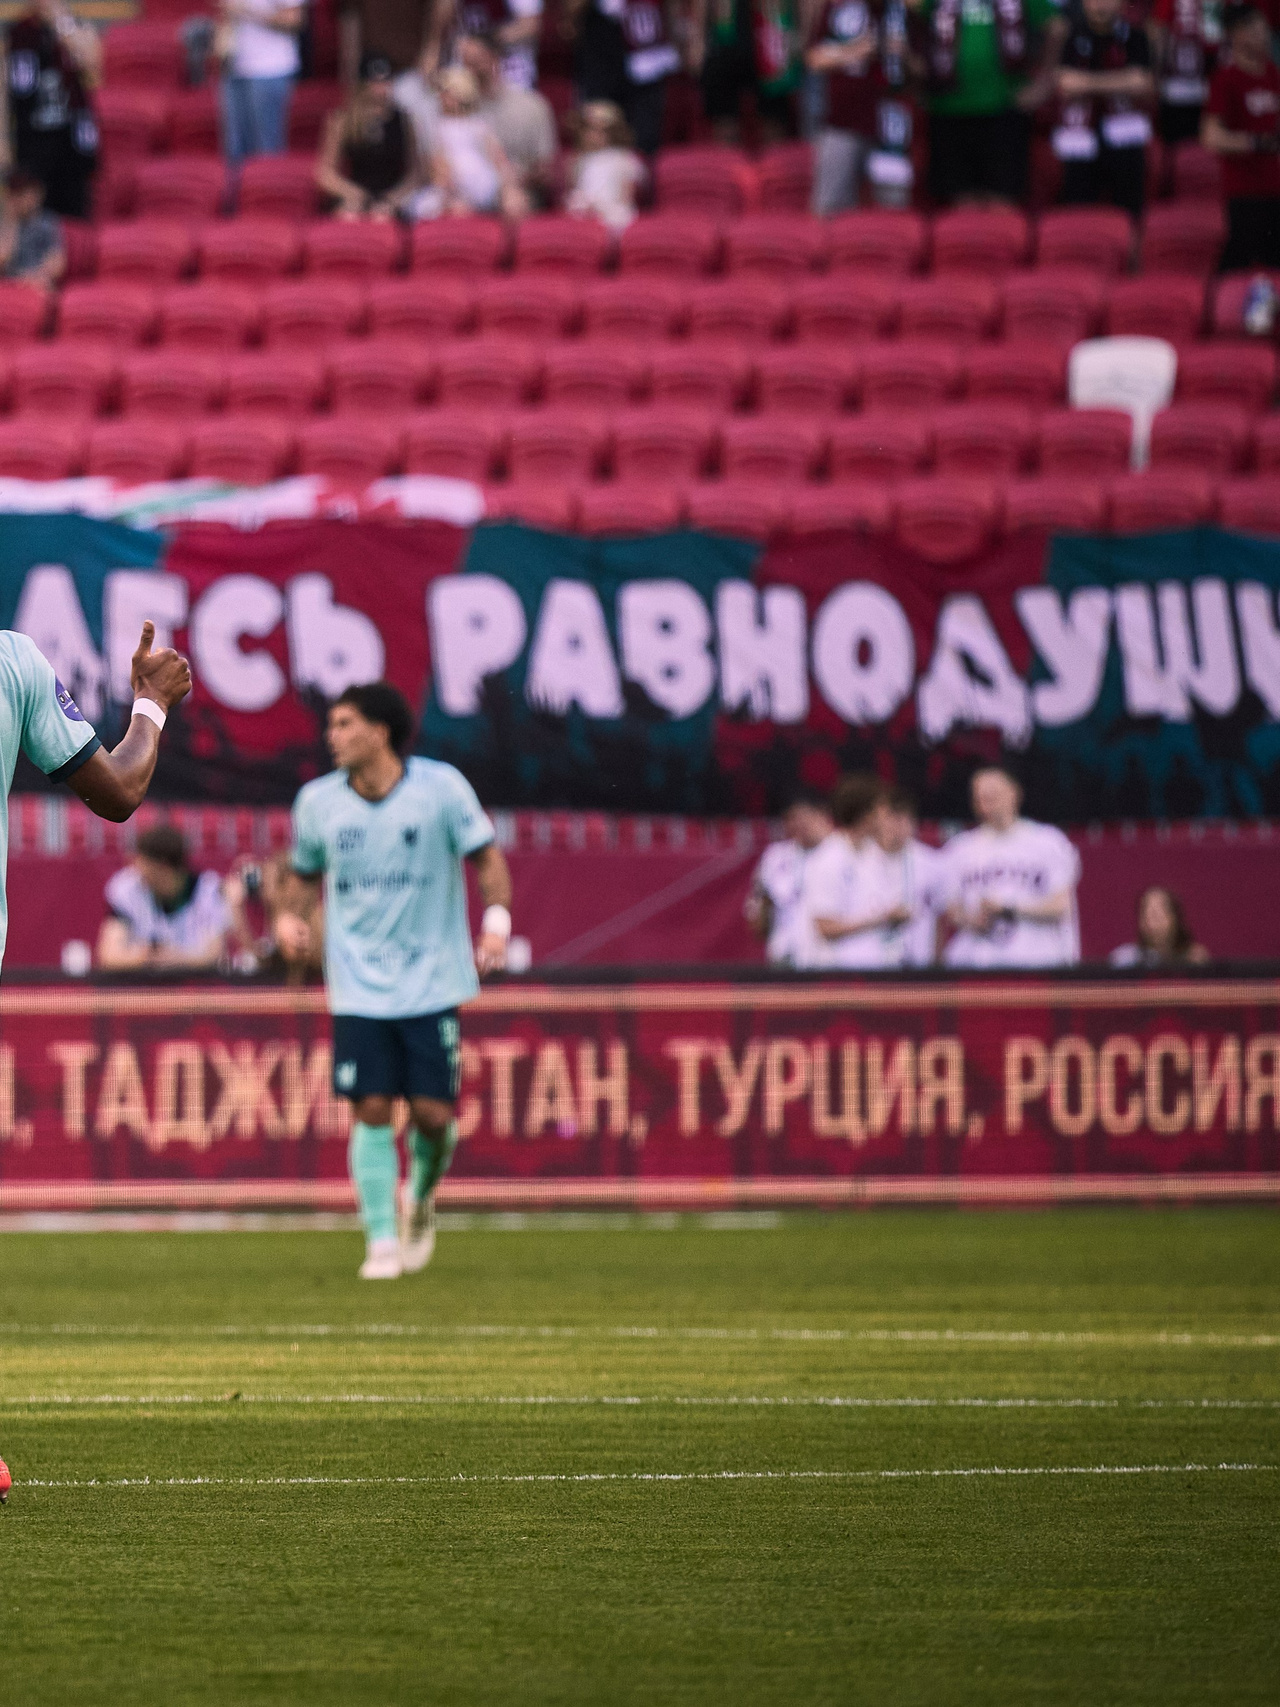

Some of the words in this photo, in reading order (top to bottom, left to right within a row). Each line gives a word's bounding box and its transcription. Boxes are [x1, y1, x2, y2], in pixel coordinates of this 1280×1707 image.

[47, 1037, 648, 1152] ТАДЖИСТАН,
[662, 1035, 986, 1147] ТУРЦИЯ,
[1002, 1033, 1280, 1136] РОССИЯ
